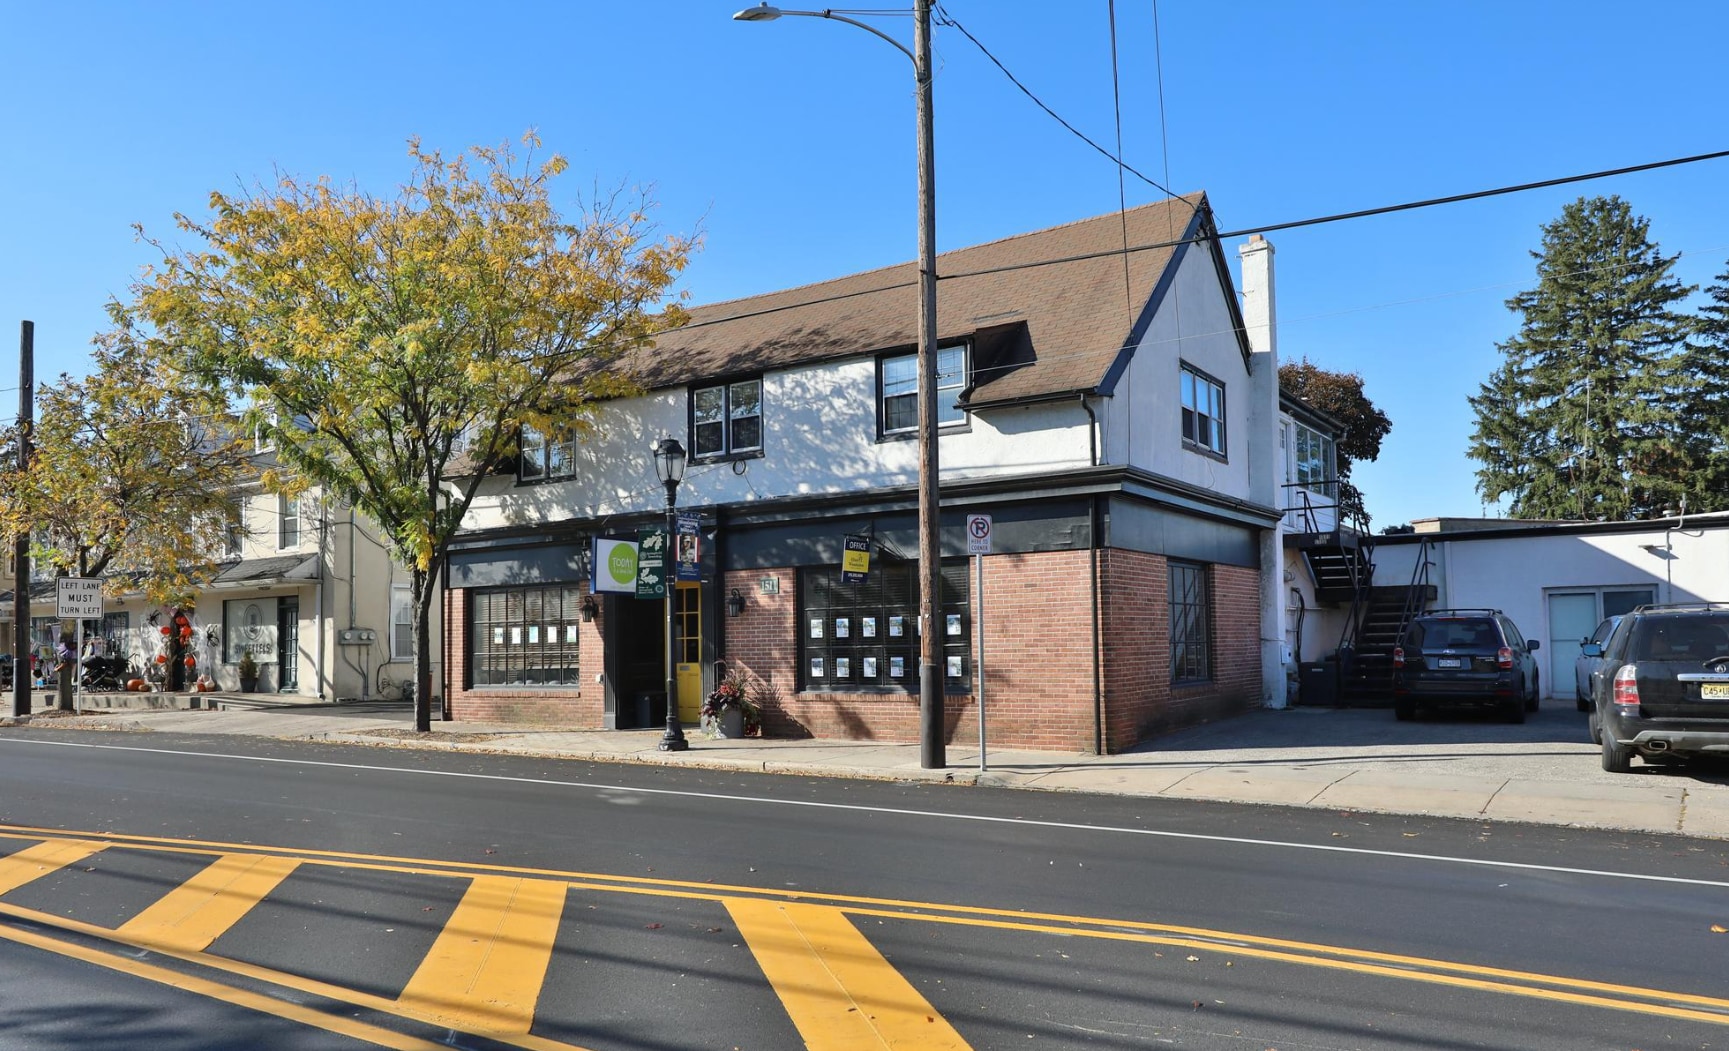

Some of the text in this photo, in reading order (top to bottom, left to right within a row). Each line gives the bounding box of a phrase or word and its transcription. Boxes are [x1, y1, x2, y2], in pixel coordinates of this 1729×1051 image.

[849, 541, 867, 551] OFFICE
[612, 557, 634, 570] TODAY
[61, 582, 101, 590] LEFT LANE
[68, 593, 93, 602] MUST
[60, 606, 101, 614] TURN LEFT
